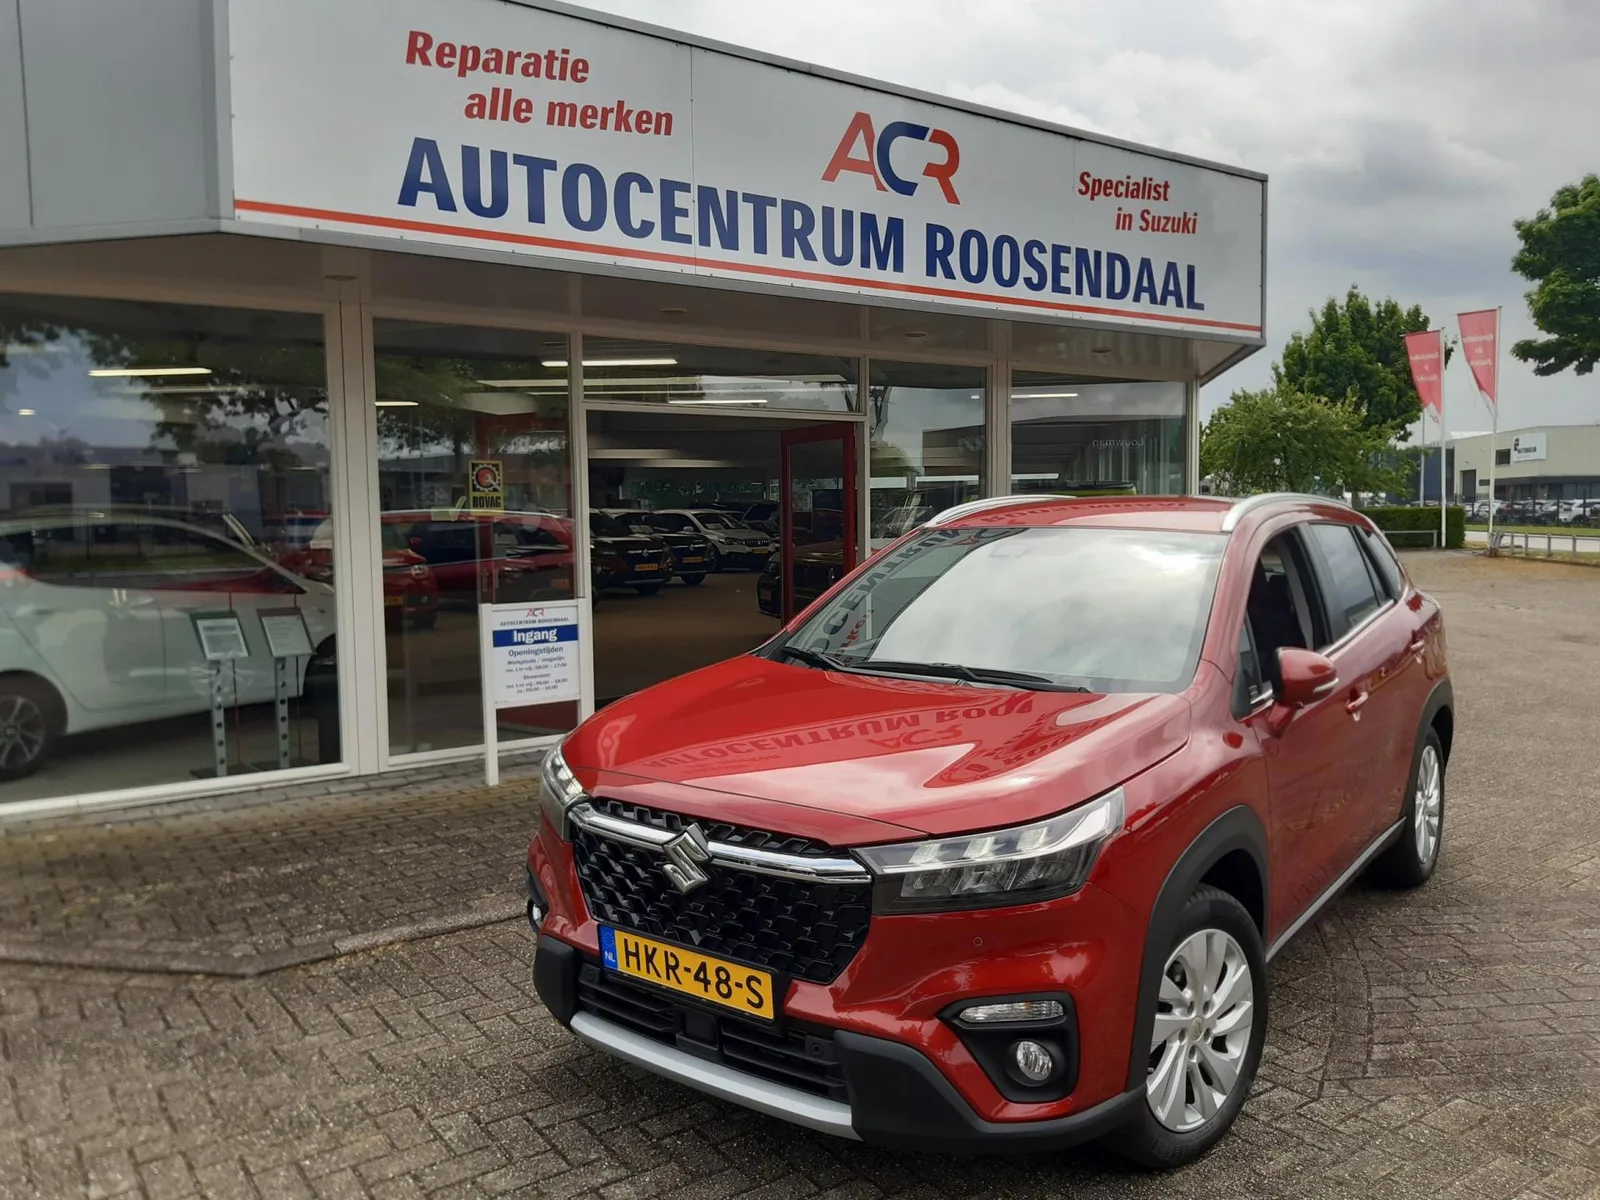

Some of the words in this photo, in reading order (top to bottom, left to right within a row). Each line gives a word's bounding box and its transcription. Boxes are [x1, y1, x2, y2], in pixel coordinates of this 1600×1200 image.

[405, 30, 590, 84] Reparatie
[464, 86, 534, 124] alle
[546, 99, 673, 136] merken
[820, 111, 961, 205] ACR
[1077, 170, 1171, 202] Specialist
[397, 136, 905, 274] AUTOCENTRUM
[925, 222, 1205, 311] ROOSENDAAL
[1114, 206, 1134, 232] in
[1138, 208, 1198, 235] Suzuki
[472, 496, 502, 508] BOVAG
[526, 608, 545, 617] ACR
[513, 628, 558, 644] Ingang
[508, 646, 564, 657] Openingstijden
[604, 950, 616, 963] NL
[623, 938, 764, 1009] HKR-48-S
